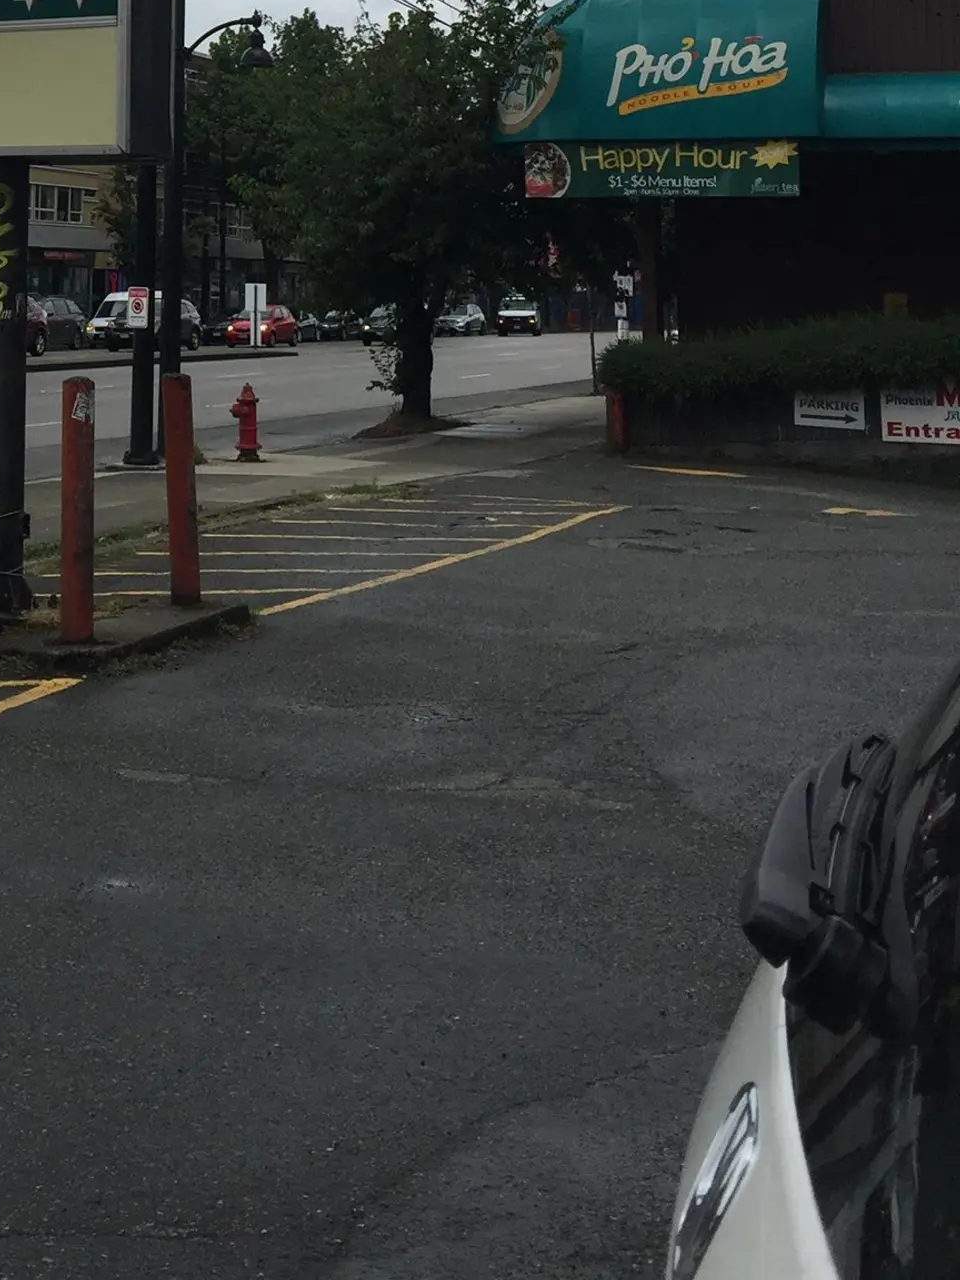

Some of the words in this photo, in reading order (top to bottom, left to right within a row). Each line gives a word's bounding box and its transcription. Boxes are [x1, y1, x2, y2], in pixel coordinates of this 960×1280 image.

[627, 91, 690, 109] NOODLE
[715, 79, 765, 93] SOUP
[579, 143, 670, 173] Happy
[675, 140, 747, 170] Hour
[608, 175, 623, 188] $1
[631, 174, 646, 188] $6
[648, 175, 681, 188] Menu
[683, 174, 717, 188] Items!
[799, 398, 860, 412] PARKING
[886, 393, 933, 406] Phoenix
